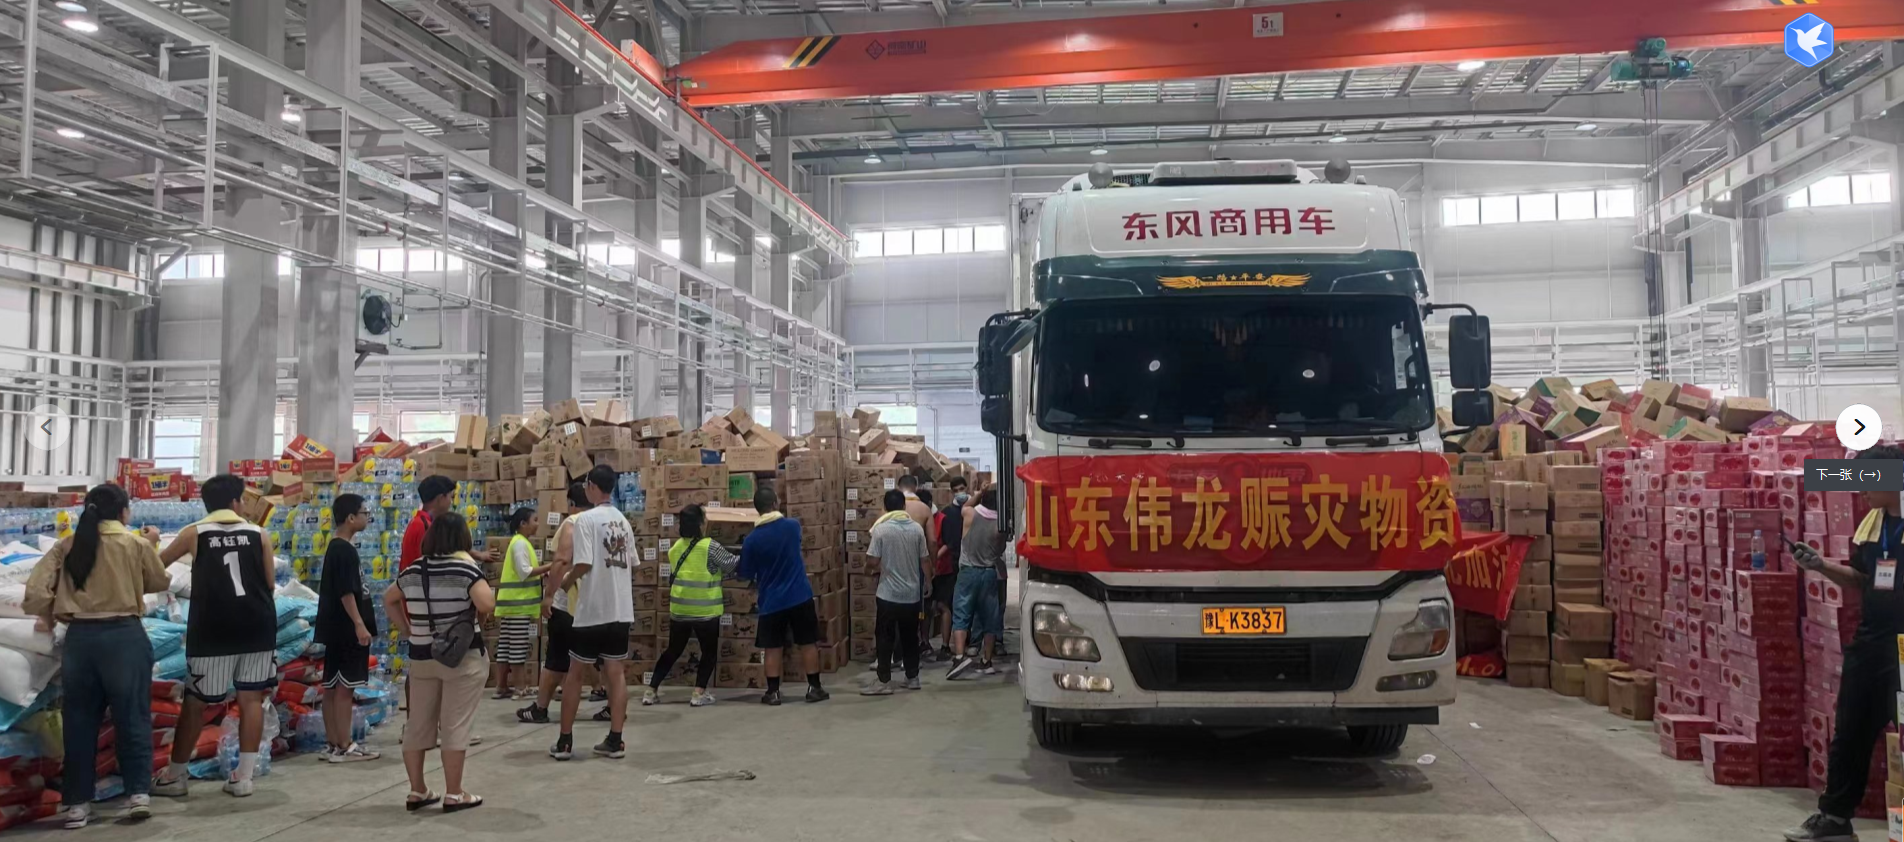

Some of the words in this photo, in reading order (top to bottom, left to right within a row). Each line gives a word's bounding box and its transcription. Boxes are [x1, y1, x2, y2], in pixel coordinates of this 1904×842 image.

[1261, 16, 1273, 29] 5t
[1121, 206, 1336, 241] 东风商用车
[1027, 474, 1457, 552] 山东伟龙赈灾物资
[223, 551, 246, 597] 1
